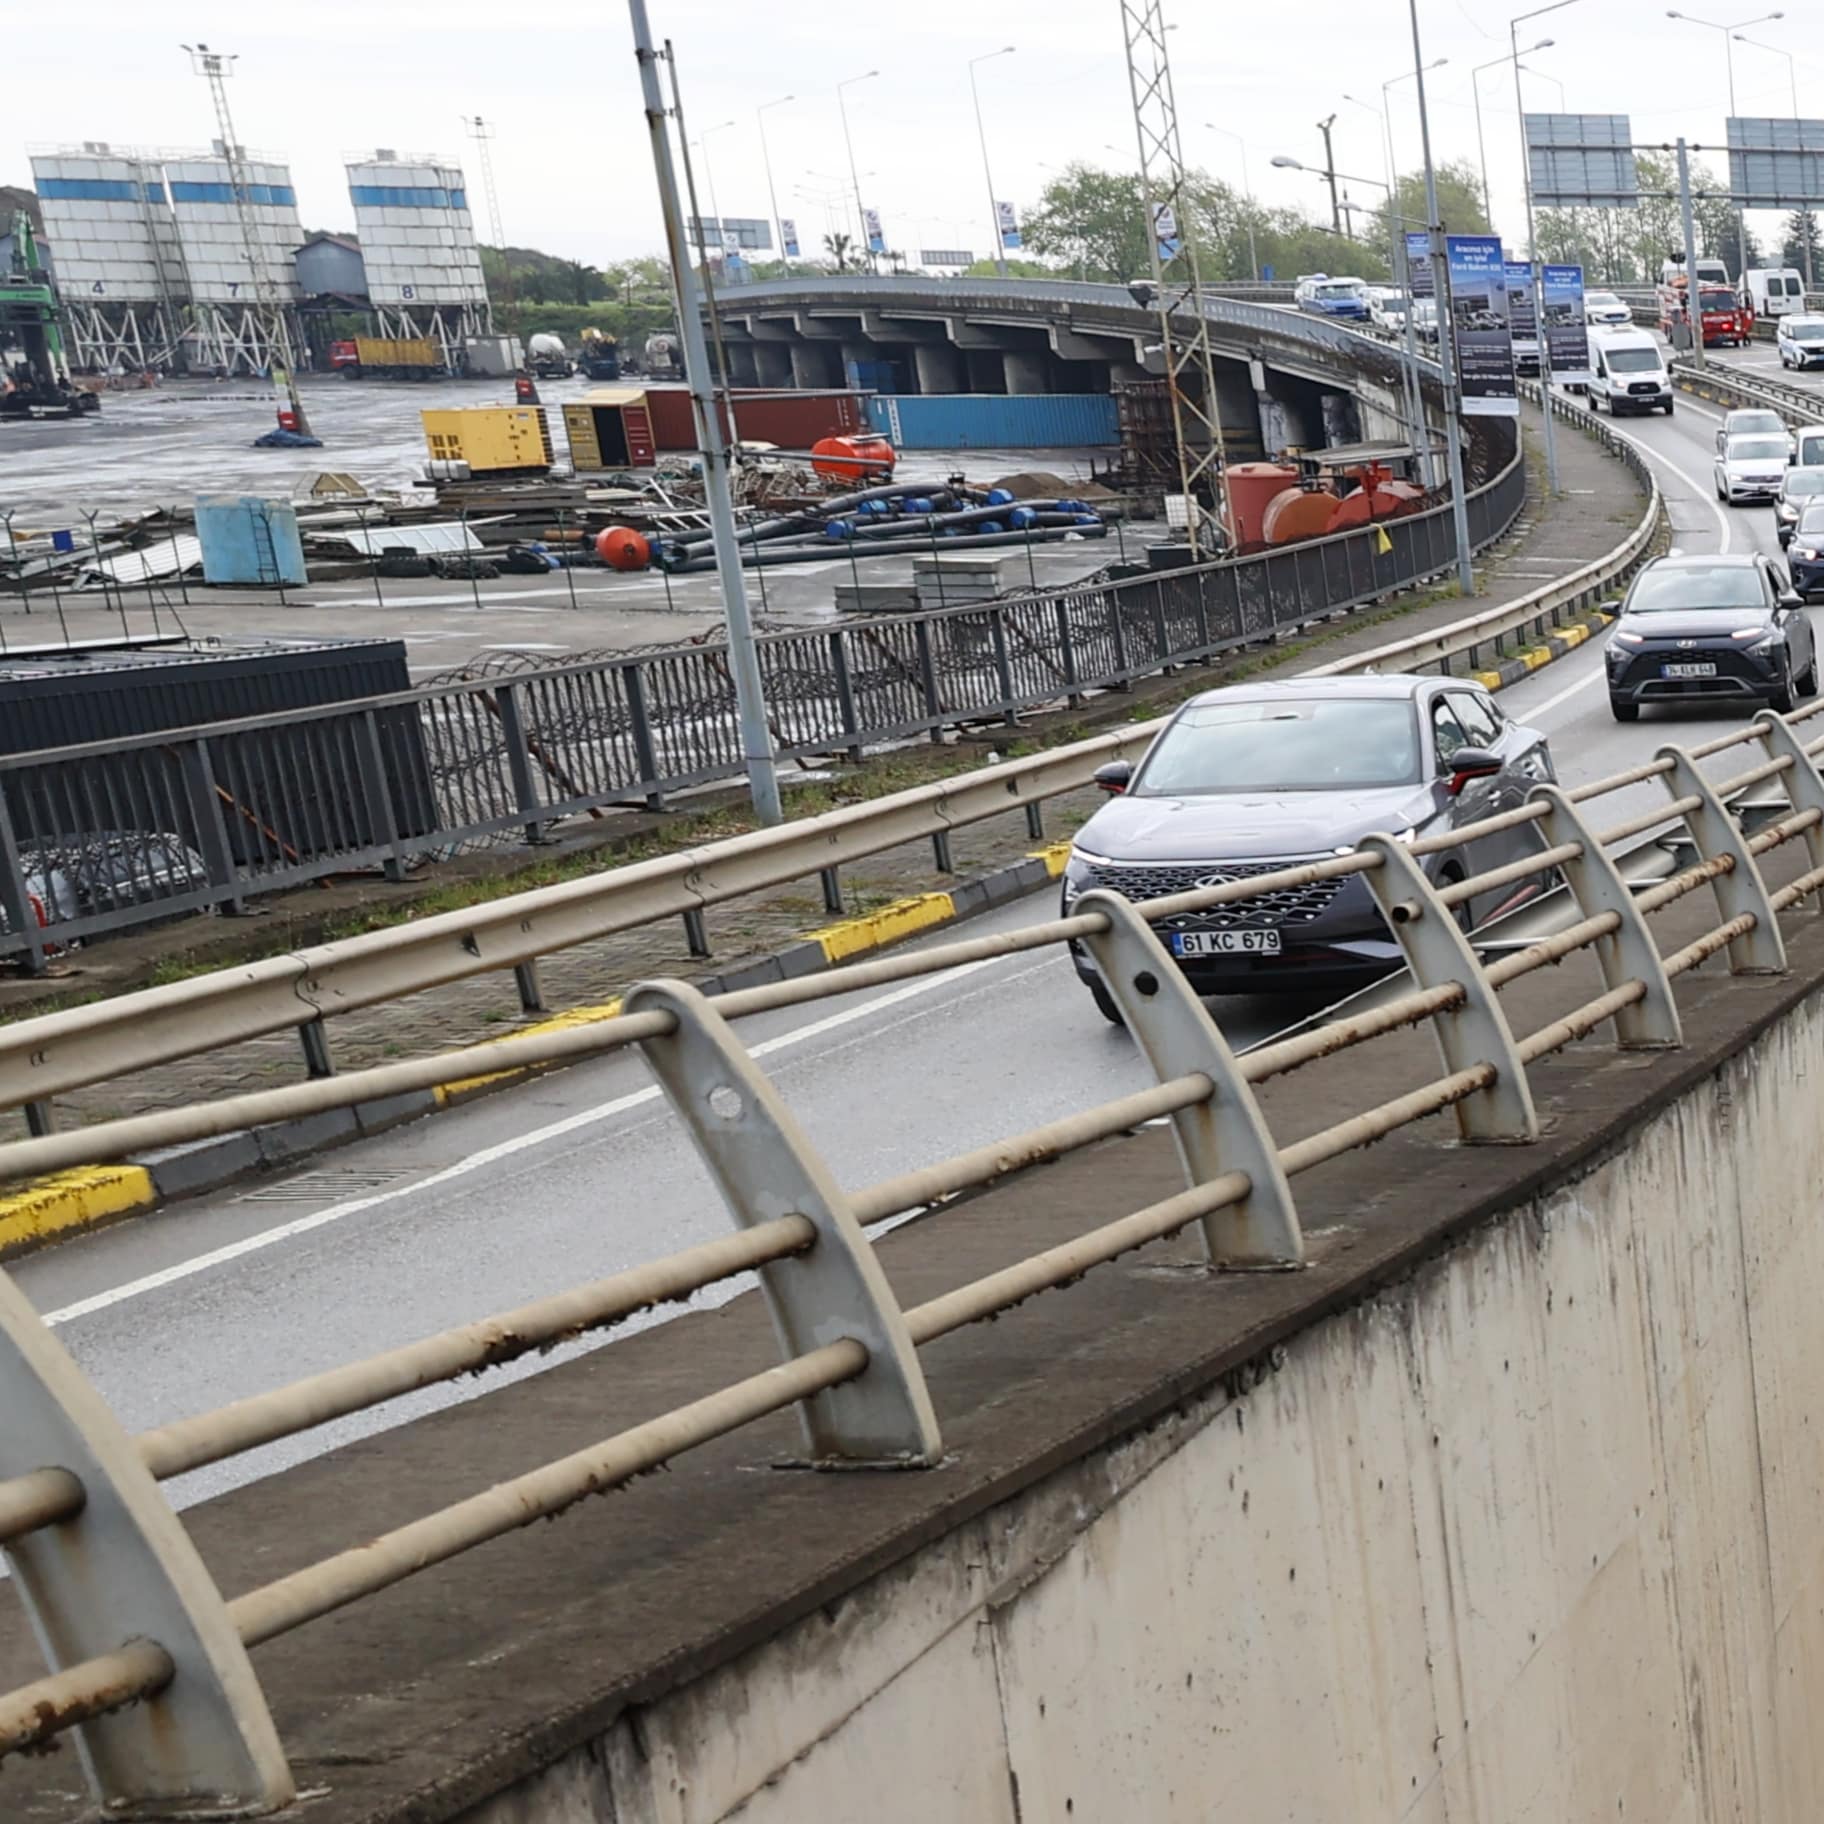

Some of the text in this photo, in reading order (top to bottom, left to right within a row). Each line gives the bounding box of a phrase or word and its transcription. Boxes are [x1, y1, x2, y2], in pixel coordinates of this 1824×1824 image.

[92, 281, 104, 295] 4
[227, 282, 239, 297] 7
[402, 285, 413, 299] 8
[1183, 931, 1279, 952] 61 KC 679
